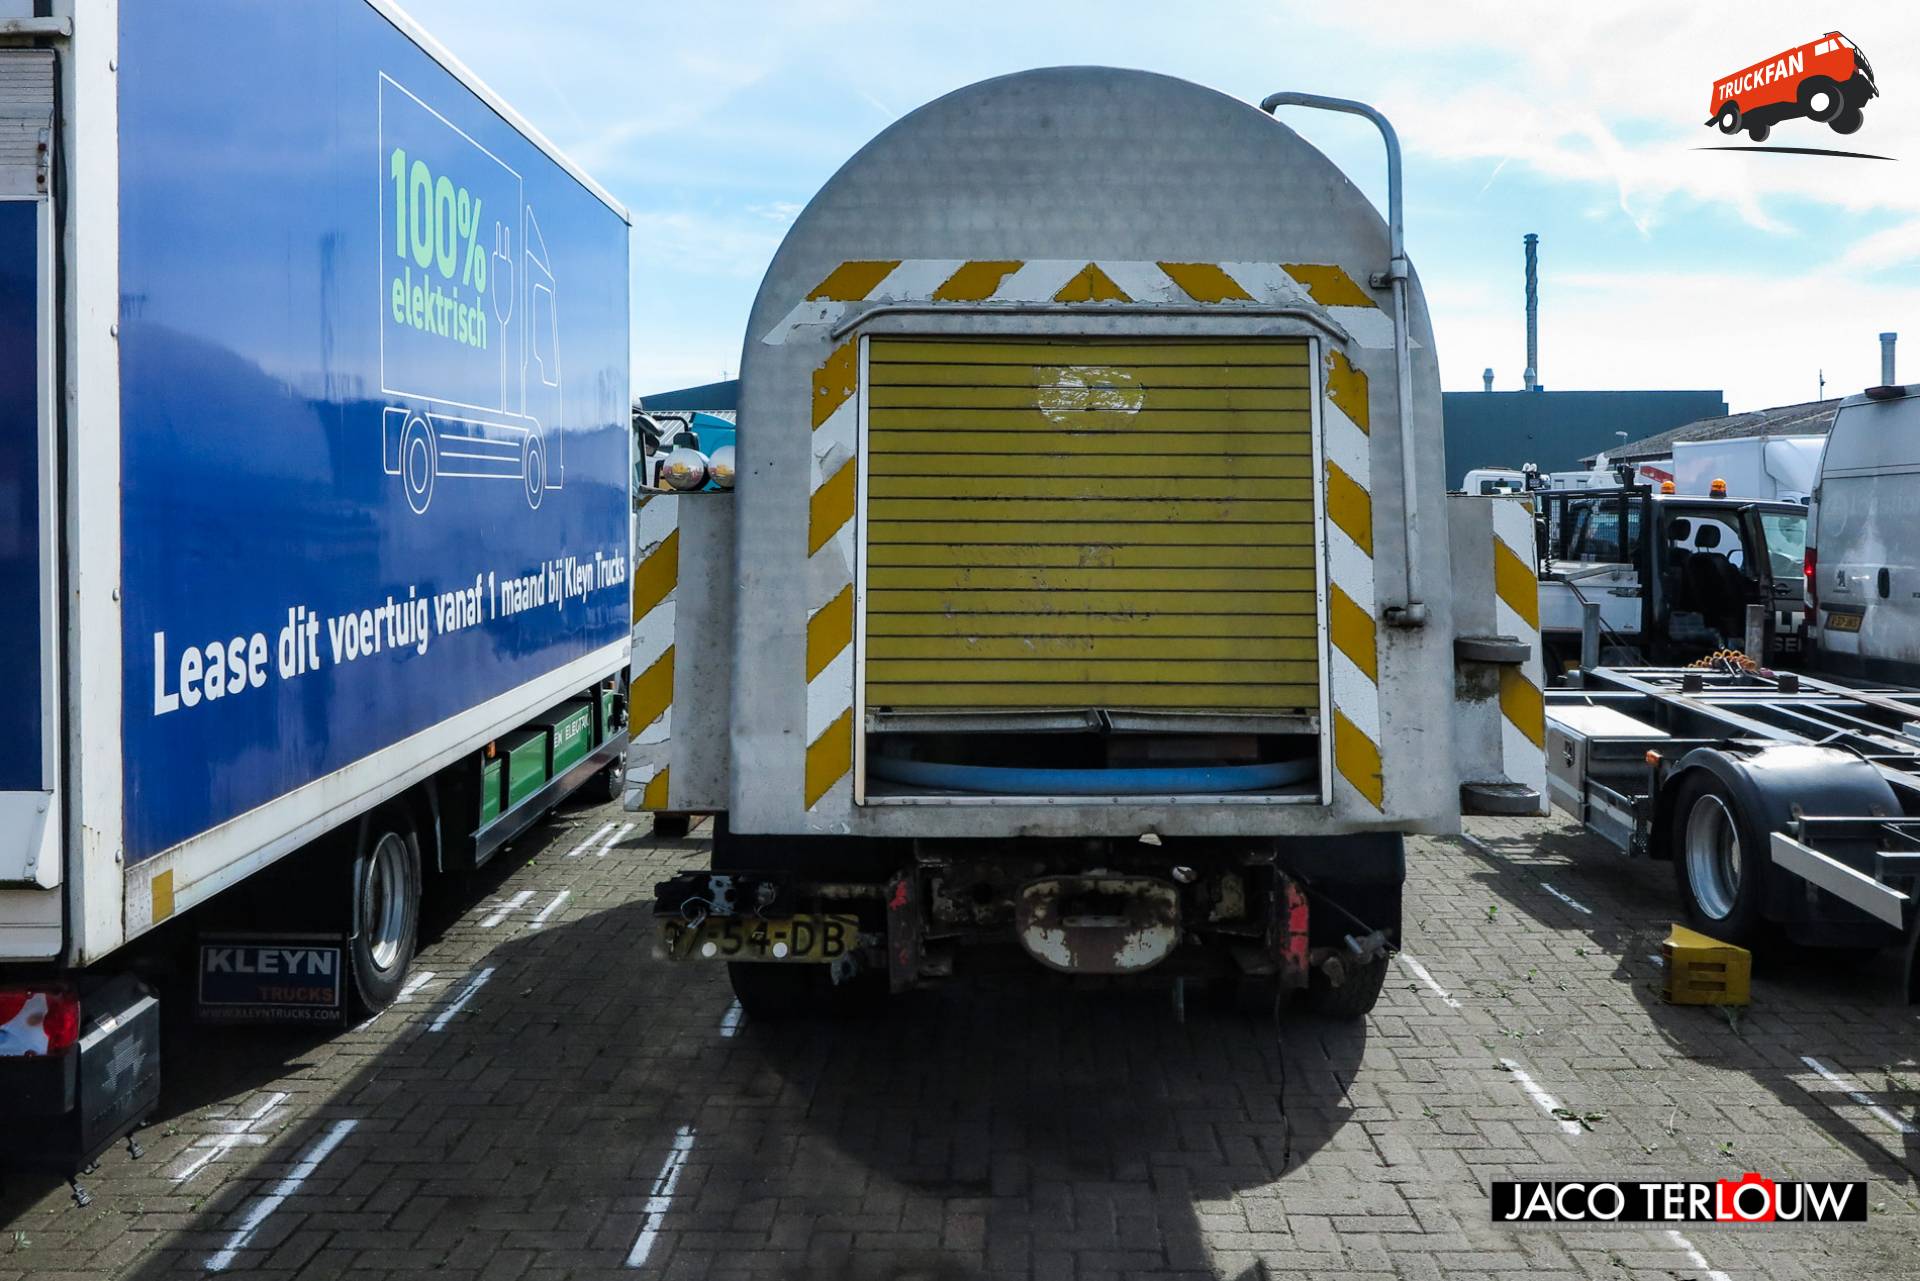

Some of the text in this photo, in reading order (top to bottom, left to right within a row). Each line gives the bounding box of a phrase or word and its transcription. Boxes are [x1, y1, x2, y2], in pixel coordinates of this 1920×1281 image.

[391, 147, 487, 294] 100%
[391, 265, 487, 350] elektrisch
[153, 549, 625, 716] Lease dit voertuig vanaf 1 maand bij Kleyn Trucks
[207, 947, 332, 976] KLEYN
[257, 985, 334, 1002] TRUCKS
